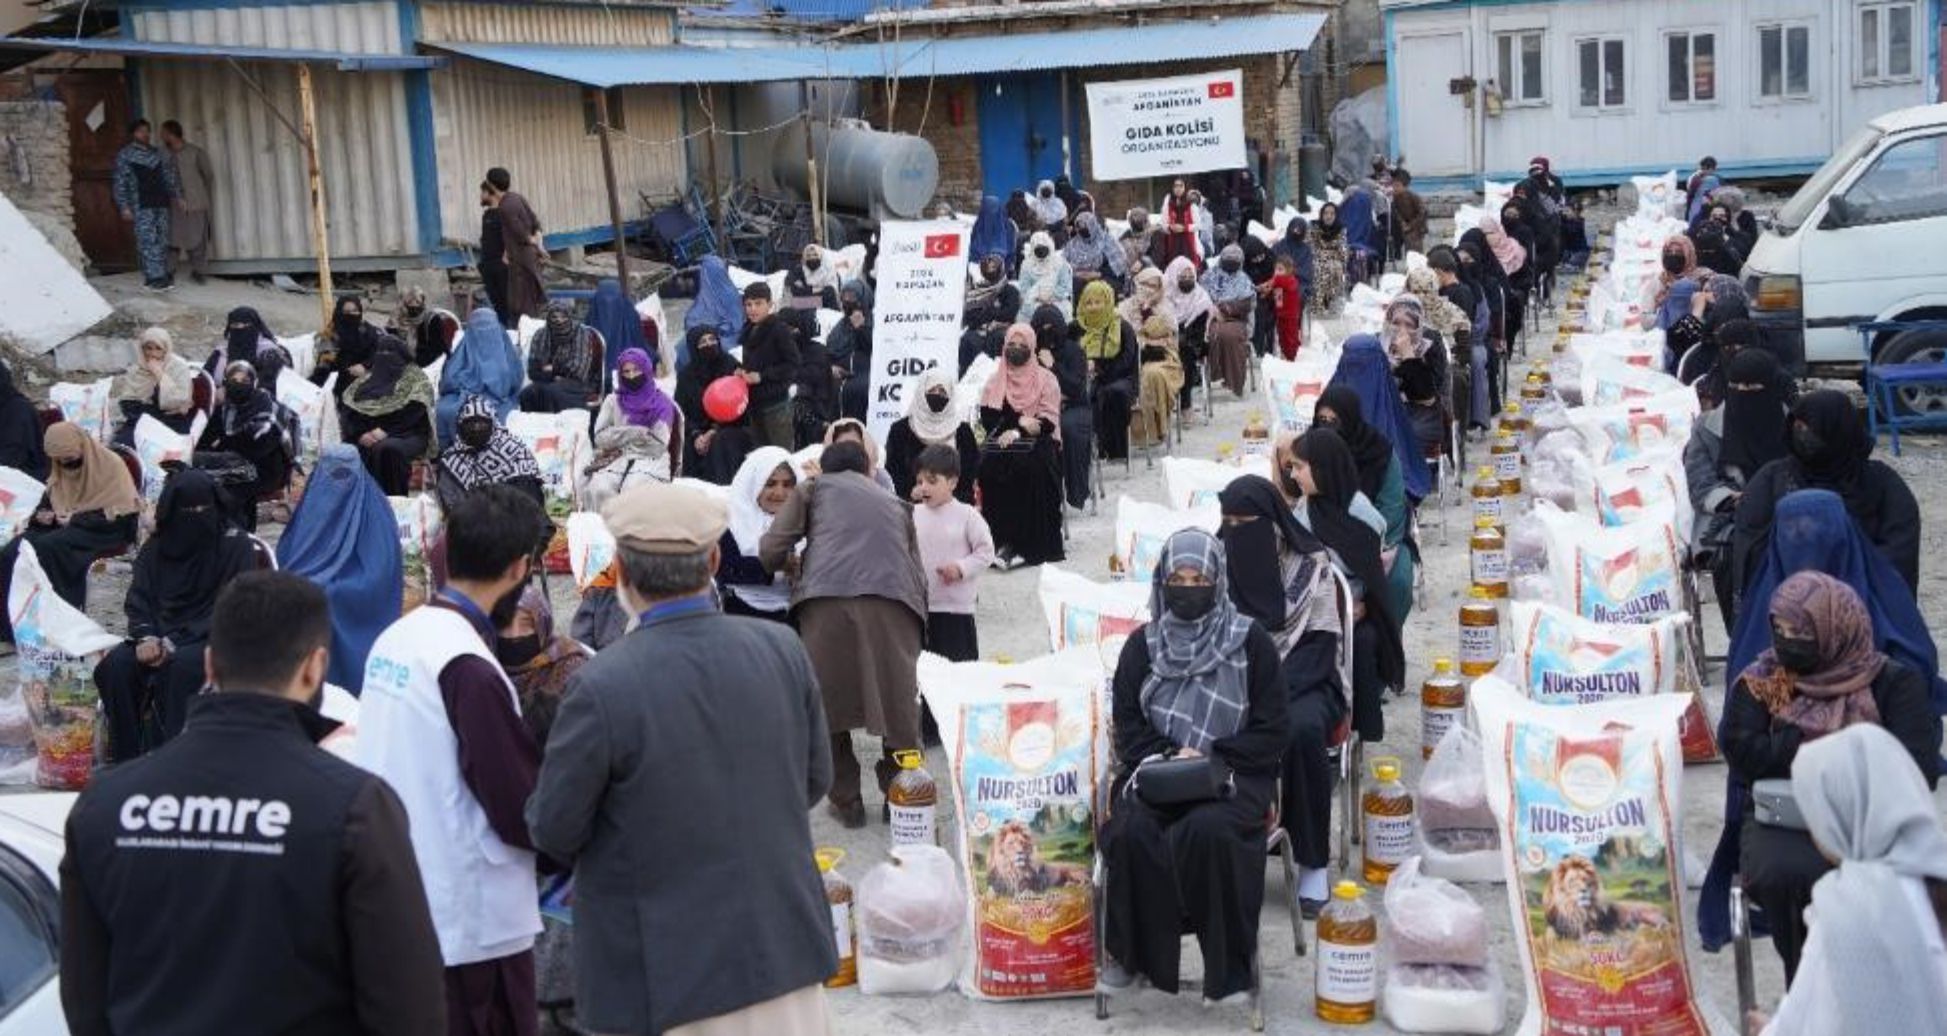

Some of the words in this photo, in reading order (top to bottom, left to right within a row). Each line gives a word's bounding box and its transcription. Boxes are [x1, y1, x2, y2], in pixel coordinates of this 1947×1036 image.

[1126, 125, 1162, 140] GIDA
[1166, 117, 1214, 136] KOLİSİ
[368, 656, 410, 689] emre
[1542, 671, 1640, 694] NURSULTON
[978, 770, 1077, 802] NURSULTON
[119, 794, 292, 837] cemre
[1530, 797, 1645, 834] NURSULTON
